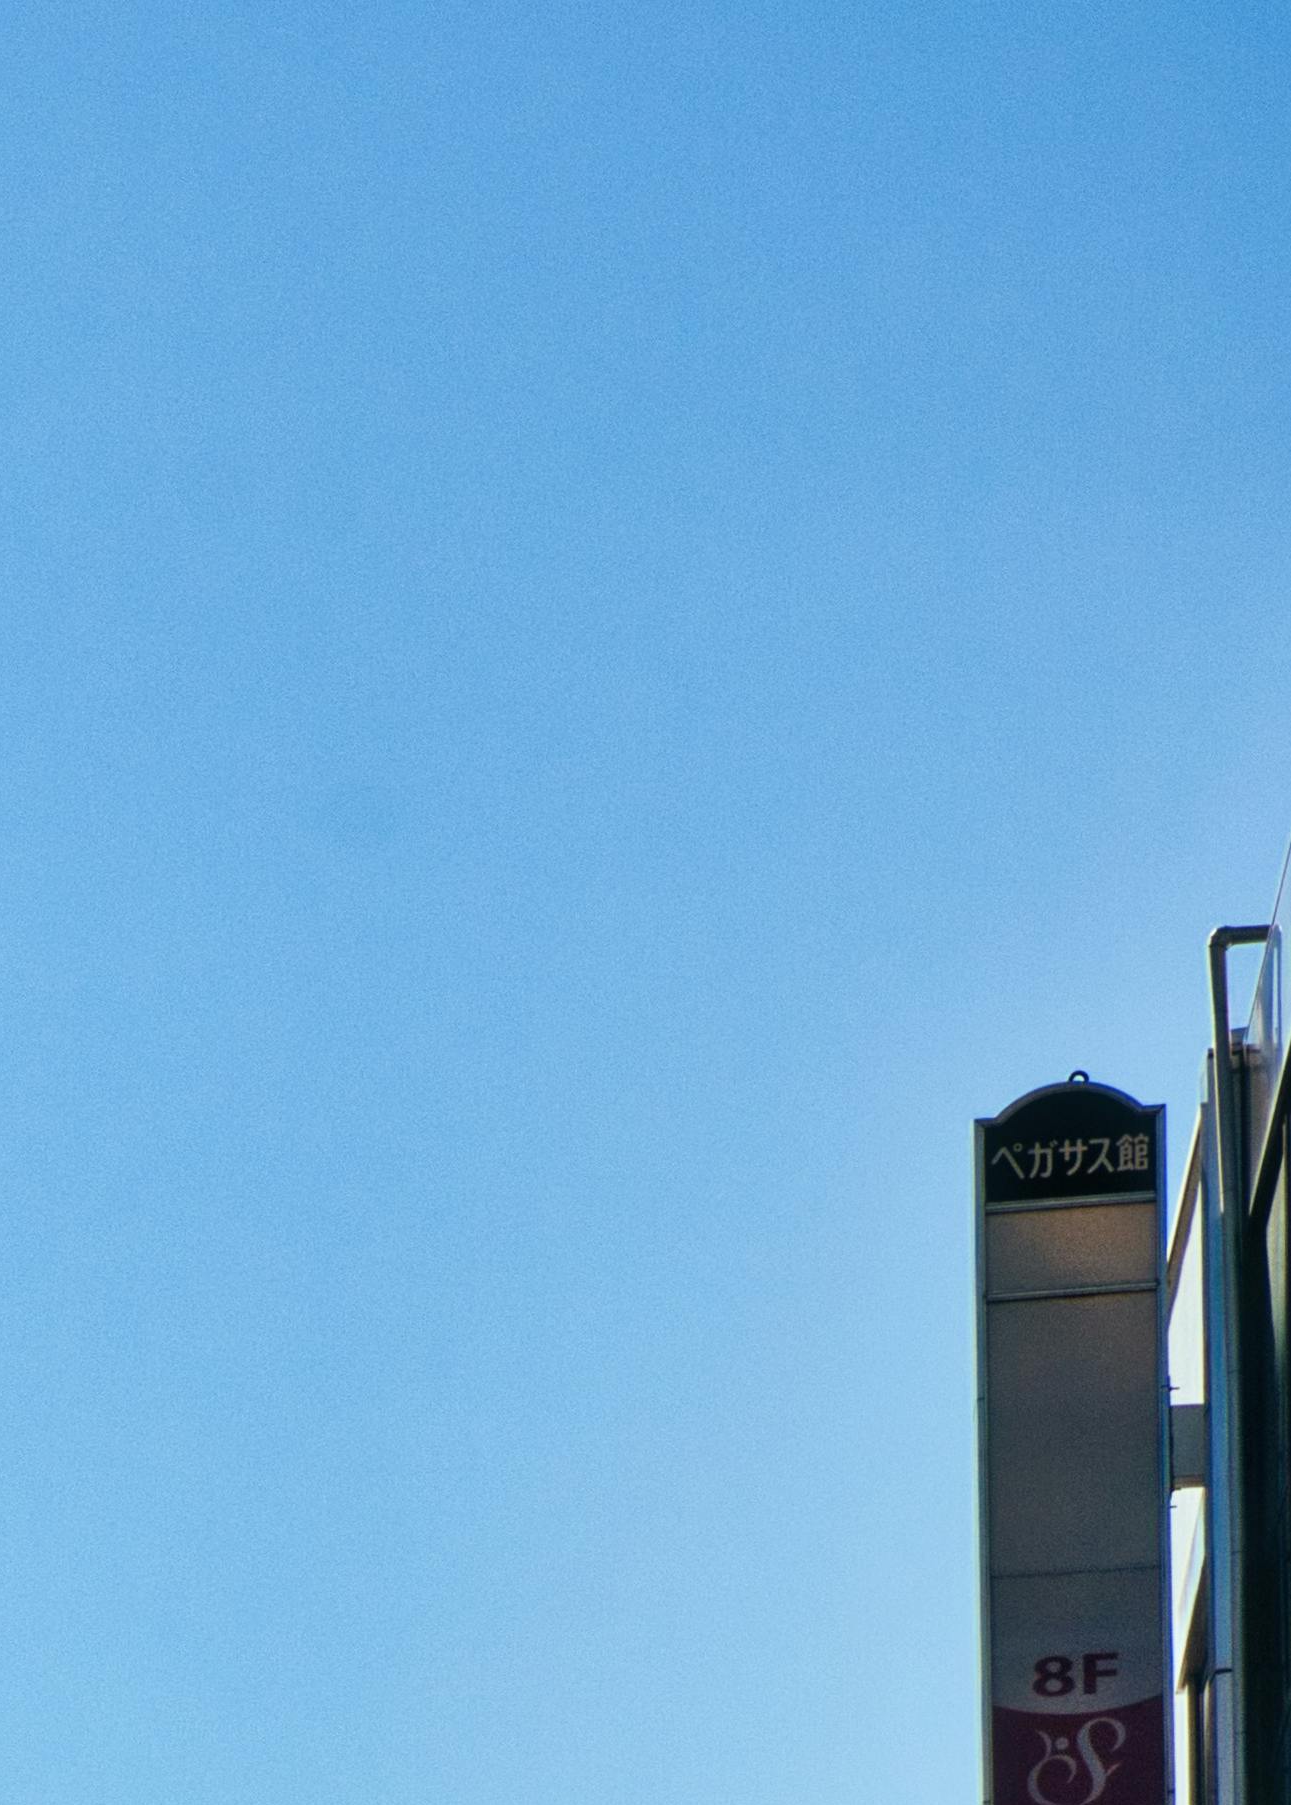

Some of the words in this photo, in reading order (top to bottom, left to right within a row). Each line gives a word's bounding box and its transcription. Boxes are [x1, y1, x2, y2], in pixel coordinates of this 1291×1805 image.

[991, 1133, 1150, 1181] ペガサス館
[1032, 1652, 1119, 1697] 8F
